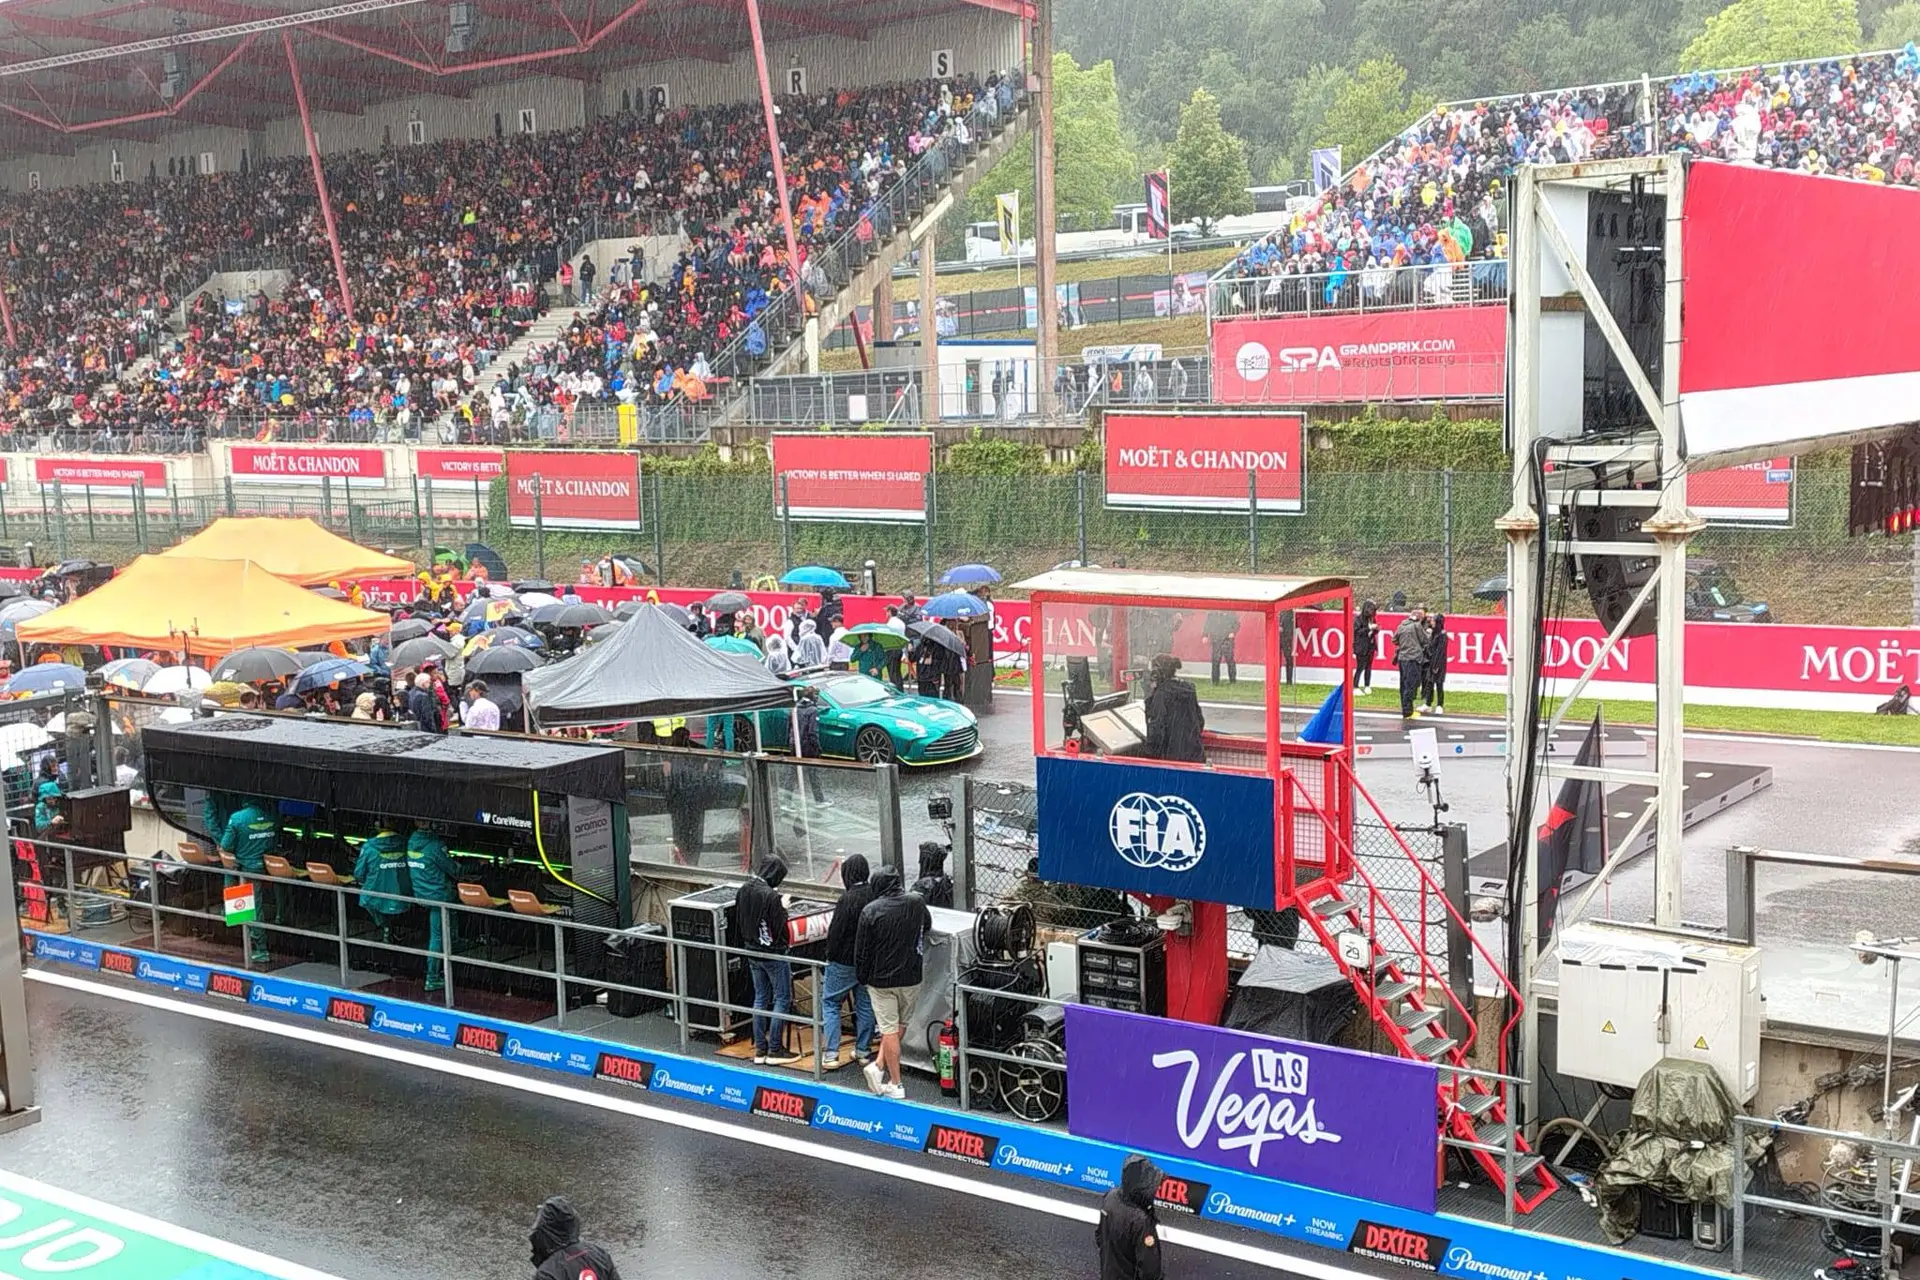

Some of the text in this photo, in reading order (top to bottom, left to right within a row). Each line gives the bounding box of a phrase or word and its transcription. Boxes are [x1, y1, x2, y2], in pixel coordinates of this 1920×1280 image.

[937, 52, 948, 76] S
[791, 70, 802, 94] R
[522, 112, 532, 131] N
[411, 123, 422, 142] M
[1279, 346, 1340, 372] SPA
[1340, 339, 1456, 356] GRANDPRIX.COM
[1343, 354, 1456, 368] #RootsOfRacing
[252, 452, 360, 473] MOËT & CHANDON
[1119, 445, 1288, 470] MOËT & CHANDON
[784, 470, 921, 482] VICTORY IS BETTER WHEN SHARED
[554, 481, 564, 495] &
[565, 481, 630, 496] CHANDON
[992, 617, 1010, 644] &
[492, 814, 532, 828] CoreWeave
[574, 818, 608, 833] aramco
[105, 952, 132, 972] DEXTER
[1346, 944, 1360, 960] 29
[213, 974, 242, 995] DEXTER
[332, 1000, 366, 1022] DEXTER
[462, 1027, 498, 1050] DEXTER
[507, 1038, 562, 1063] Paramount+
[604, 1056, 642, 1082] DEXTER
[1257, 1052, 1304, 1091] LAS
[654, 1069, 715, 1096] Paramount+
[725, 1086, 742, 1097] NOW
[760, 1090, 804, 1118] DEXTER
[1152, 1050, 1342, 1168] Vegas
[753, 1109, 810, 1126] RESURRECTION
[816, 1104, 884, 1134] Paramount+
[890, 1131, 920, 1144] STREAMING
[895, 1124, 914, 1135] NOW
[936, 1128, 985, 1159] DEXTER
[928, 1148, 990, 1168] RESURRECTION
[996, 1144, 1074, 1176] Paramount+
[1081, 1174, 1115, 1188] STREAMING
[1086, 1166, 1109, 1178] NOW
[1210, 1192, 1296, 1228] Paramount+
[1305, 1226, 1344, 1242] STREAMING
[1312, 1218, 1336, 1230] NOW
[1365, 1224, 1429, 1262] DEXTER
[1354, 1246, 1436, 1272] RESURRECTION
[1446, 1247, 1548, 1280] Paramount+
